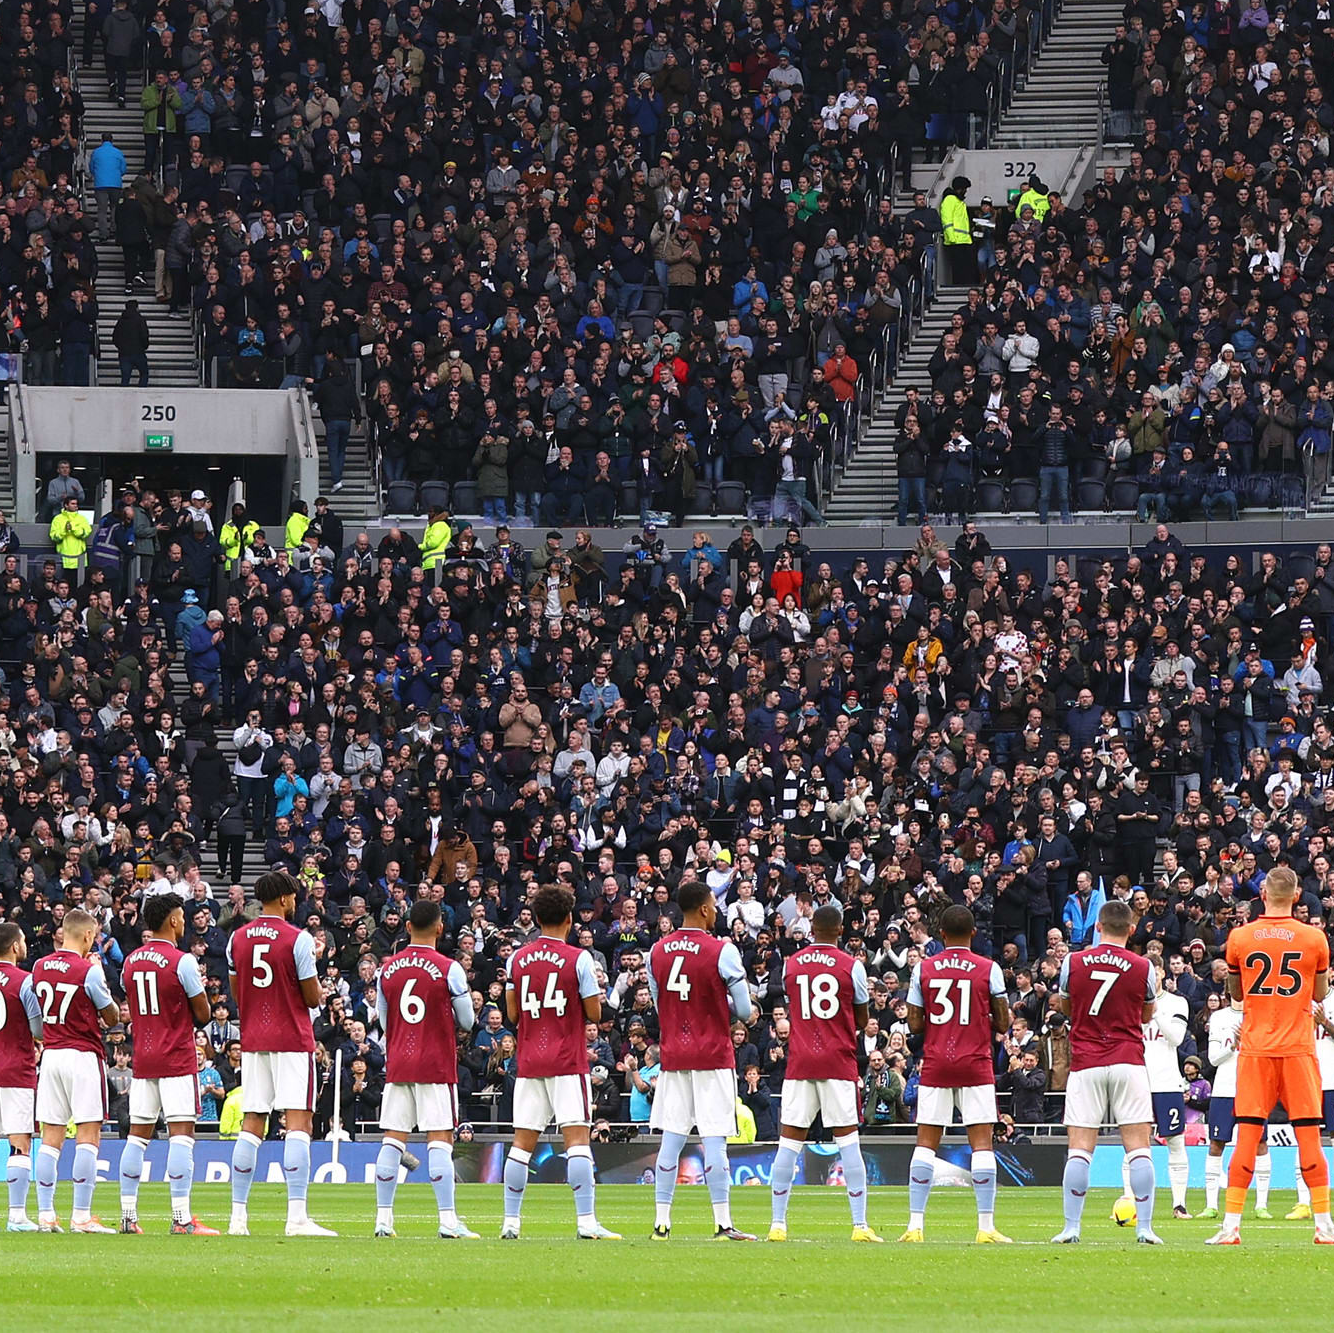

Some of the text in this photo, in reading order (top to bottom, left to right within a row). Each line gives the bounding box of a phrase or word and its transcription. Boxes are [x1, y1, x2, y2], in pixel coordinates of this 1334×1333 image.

[1004, 162, 1037, 177] 322
[141, 405, 176, 421] 250
[246, 927, 279, 941] MINGS
[1253, 929, 1295, 943] OLSEN
[663, 939, 701, 955] KONSA
[252, 944, 274, 989] 5
[383, 958, 443, 982] DOUGLAS LUIZ
[518, 953, 566, 969] KAMARA
[796, 954, 837, 968] YOUNG
[933, 960, 976, 974] BAILEY
[1082, 955, 1133, 973] McGINN
[667, 956, 691, 1002] 4
[1245, 951, 1304, 997] 25
[35, 981, 80, 1025] 27
[132, 971, 160, 1016] 11
[399, 978, 426, 1025] 6
[520, 972, 568, 1019] 44
[796, 973, 840, 1020] 18
[928, 978, 972, 1026] 31
[1089, 970, 1121, 1016] 7
[1168, 1108, 1180, 1125] 2
